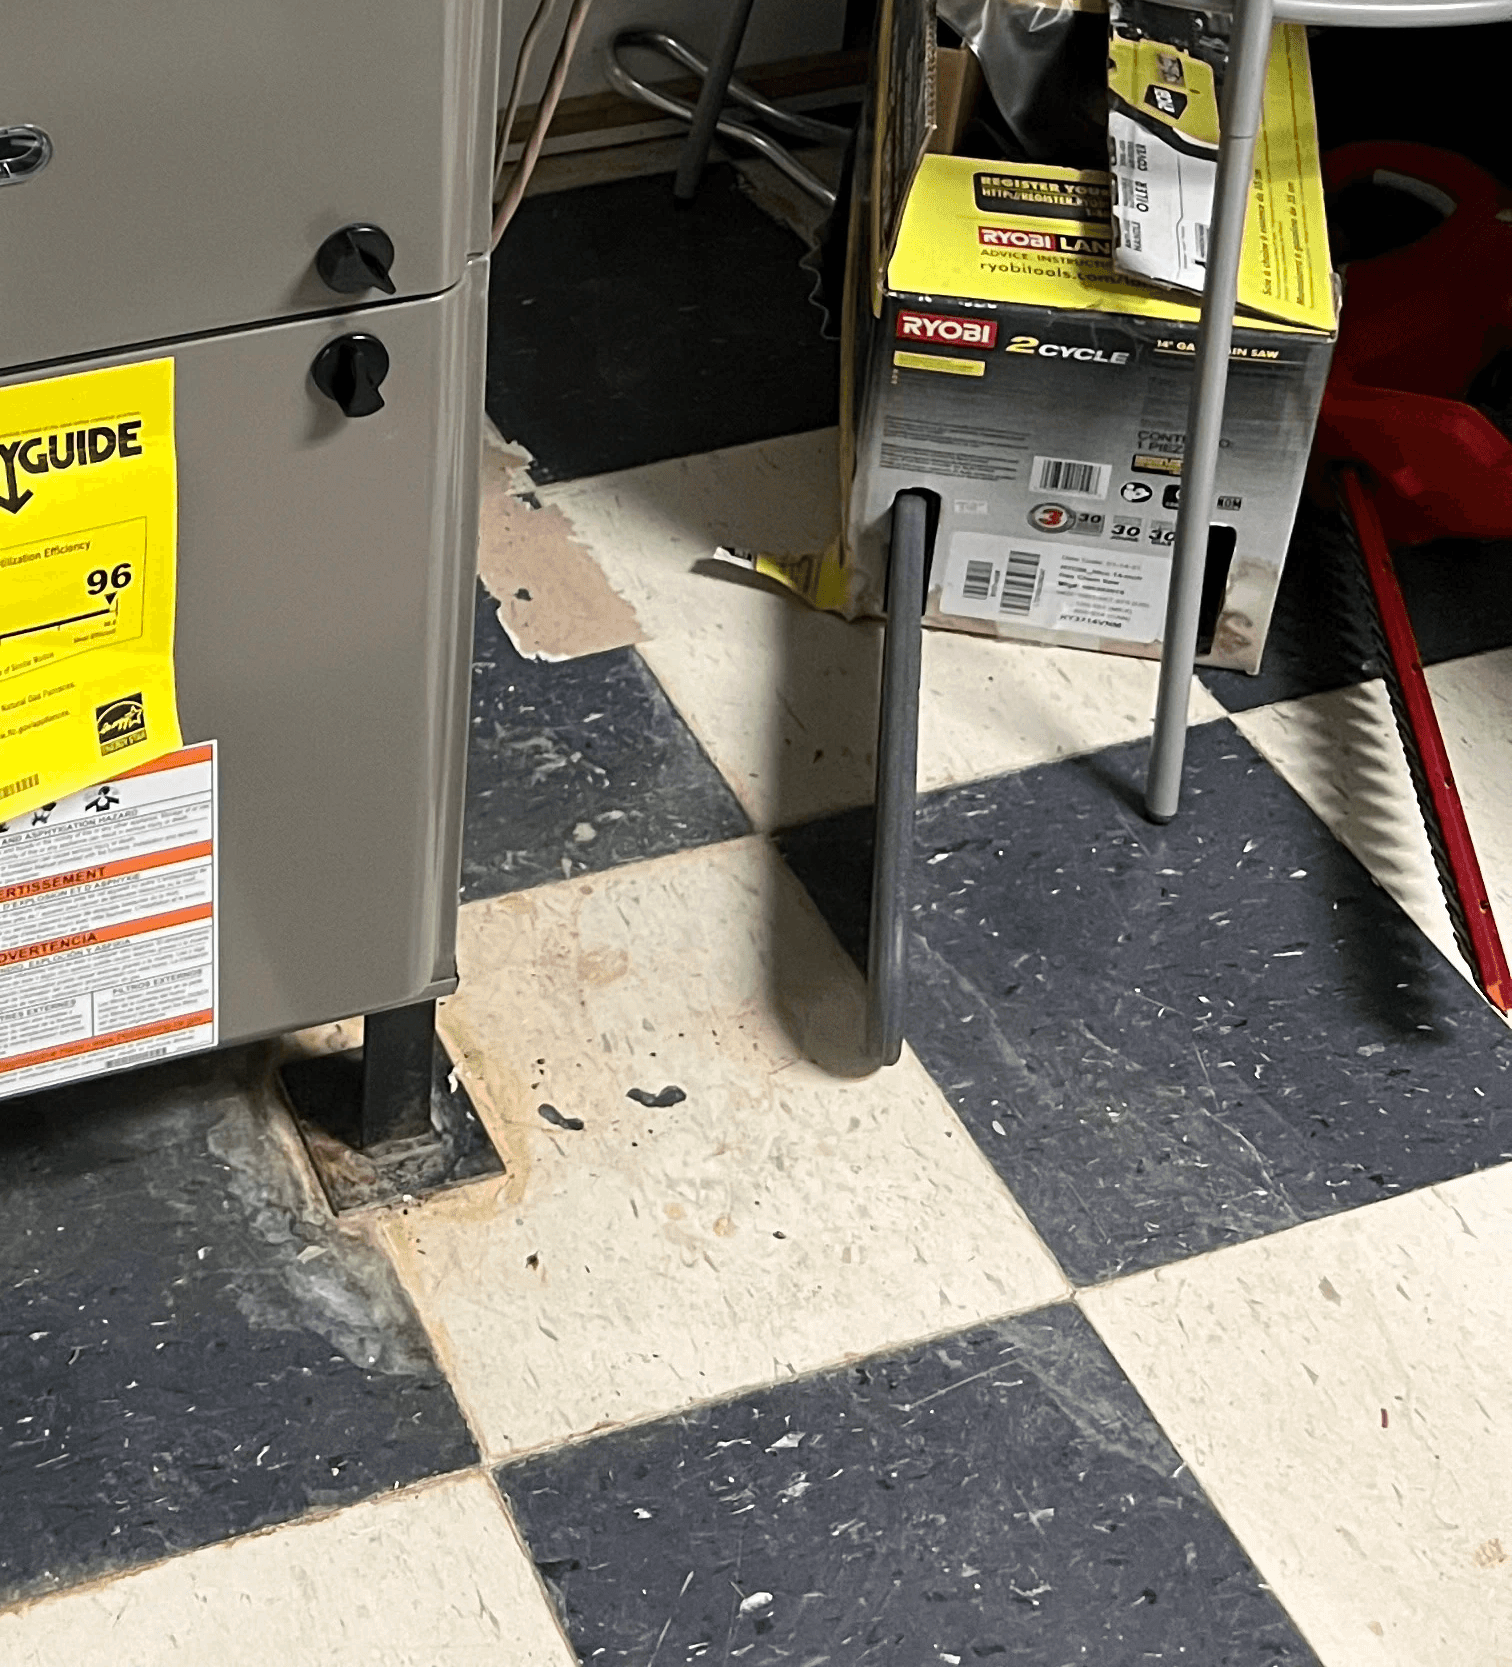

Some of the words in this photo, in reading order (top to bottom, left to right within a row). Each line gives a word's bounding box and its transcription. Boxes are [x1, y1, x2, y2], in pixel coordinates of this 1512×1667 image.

[1136, 180, 1150, 213] OILER
[982, 228, 1052, 249] RYOBI
[902, 314, 990, 345] RYOBI
[1250, 347, 1279, 360] SAW
[87, 563, 132, 595] 96
